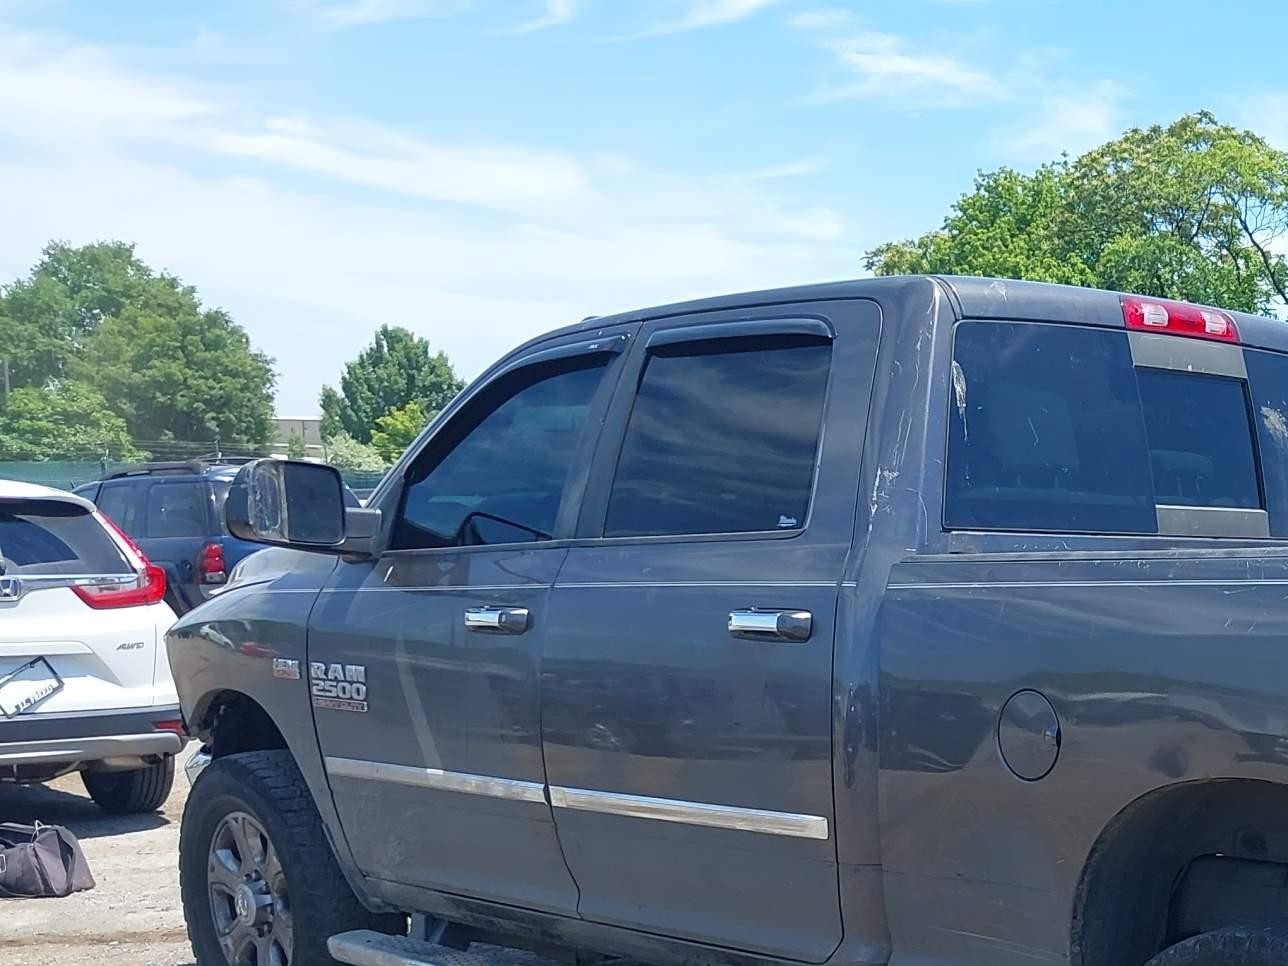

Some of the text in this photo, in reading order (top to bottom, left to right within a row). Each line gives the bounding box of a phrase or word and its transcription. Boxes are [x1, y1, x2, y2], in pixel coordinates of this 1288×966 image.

[116, 641, 145, 651] AWD
[310, 662, 366, 682] RAM
[312, 680, 367, 700] 2500
